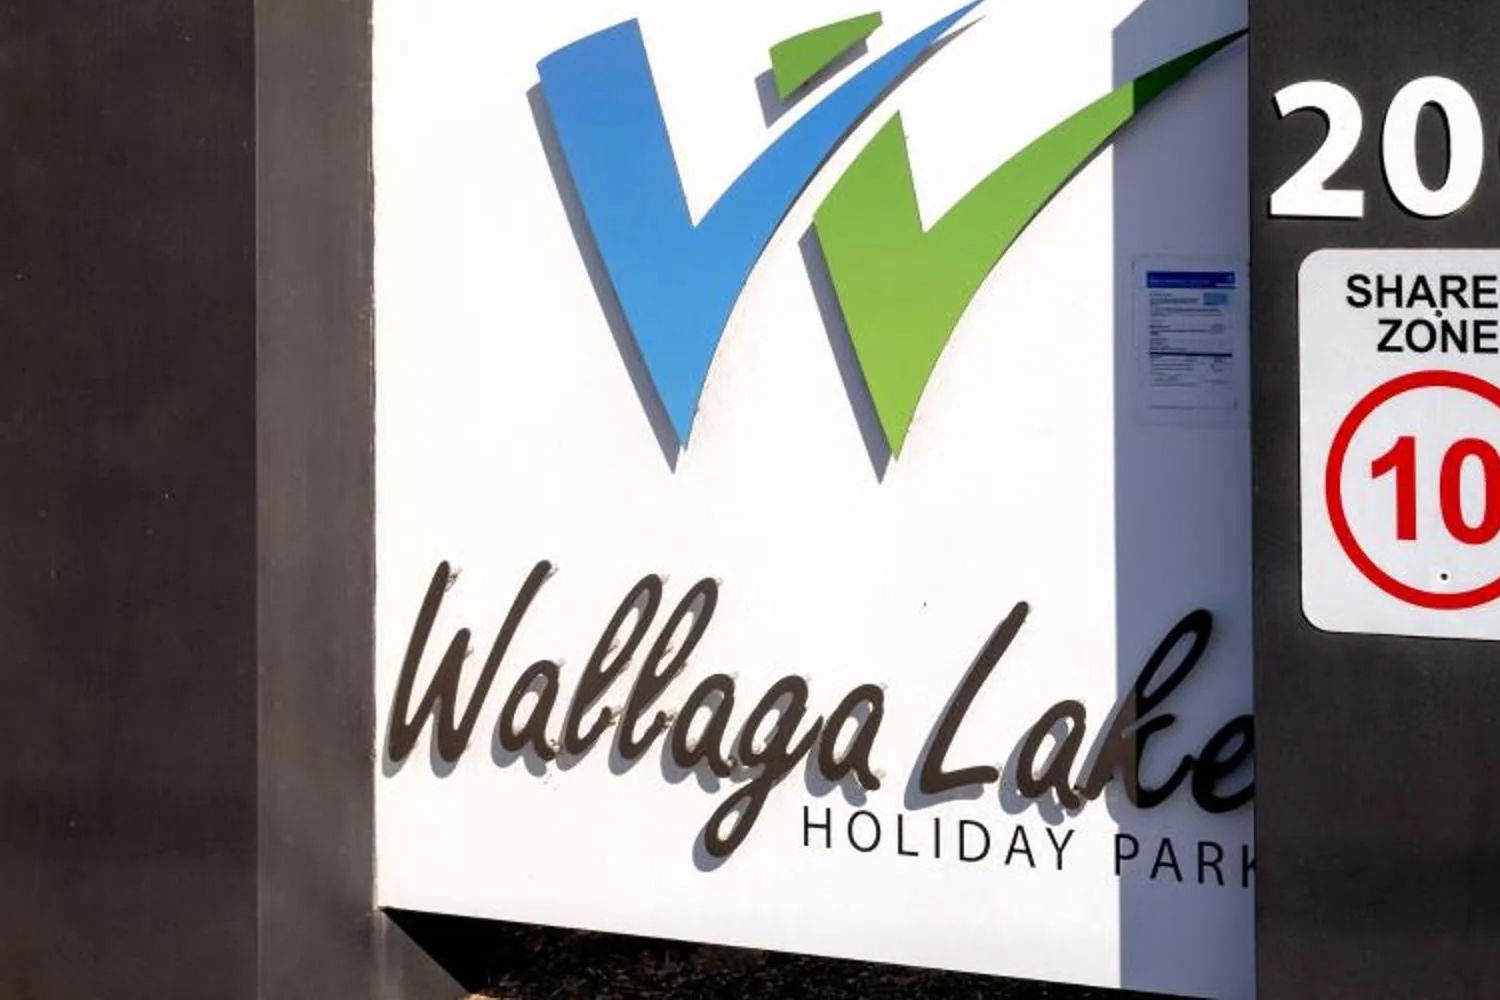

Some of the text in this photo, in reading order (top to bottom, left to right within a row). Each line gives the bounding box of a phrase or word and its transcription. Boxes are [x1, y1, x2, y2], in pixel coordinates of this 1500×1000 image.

[1377, 318, 1499, 354] ZONE
[389, 559, 1255, 857] Wallaga Lake
[802, 805, 1076, 871] HOLIDAY
